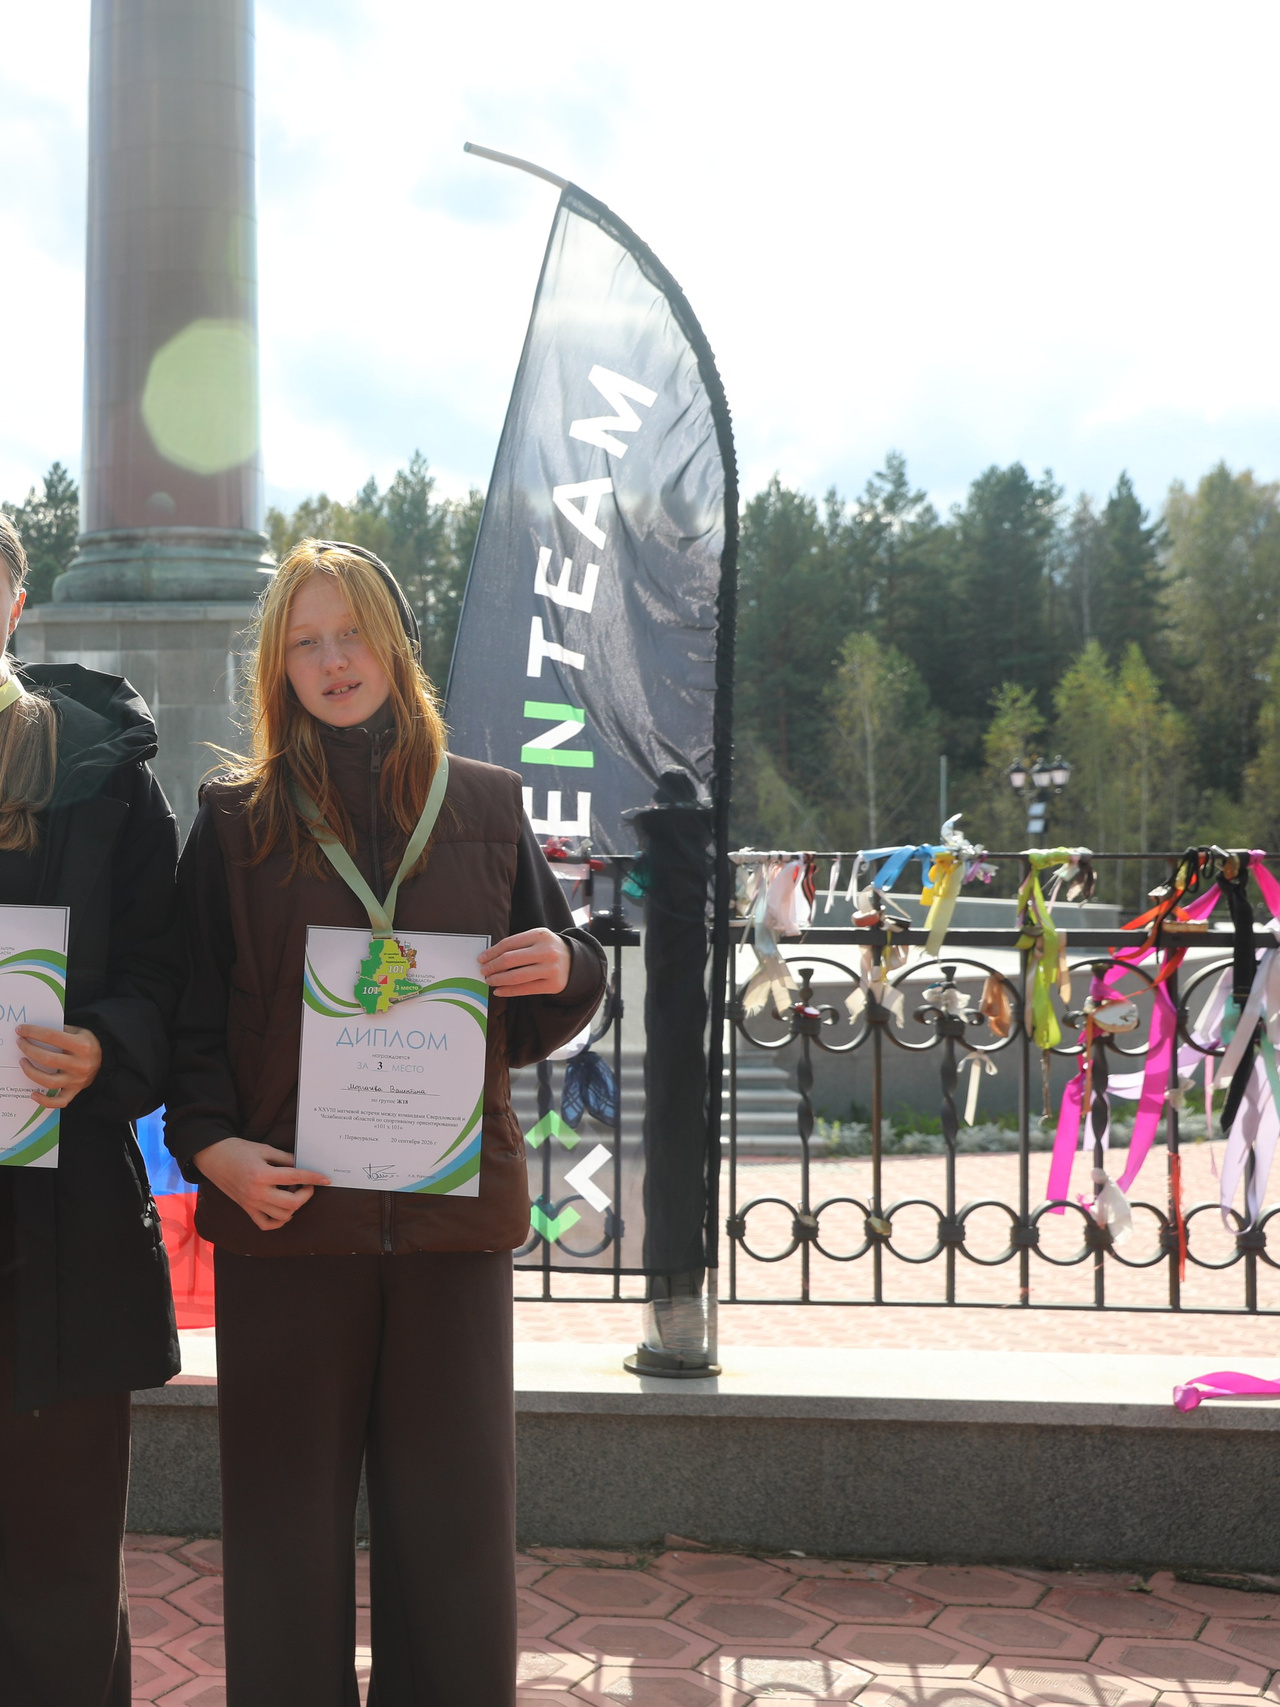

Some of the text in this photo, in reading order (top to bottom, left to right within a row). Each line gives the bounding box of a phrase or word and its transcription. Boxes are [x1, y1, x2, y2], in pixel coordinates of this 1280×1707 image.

[388, 965, 405, 973] 101
[362, 986, 379, 995] 101
[336, 1026, 447, 1051] ДИПЛОМ
[357, 1061, 424, 1074] ЗА 3 МЕСТО
